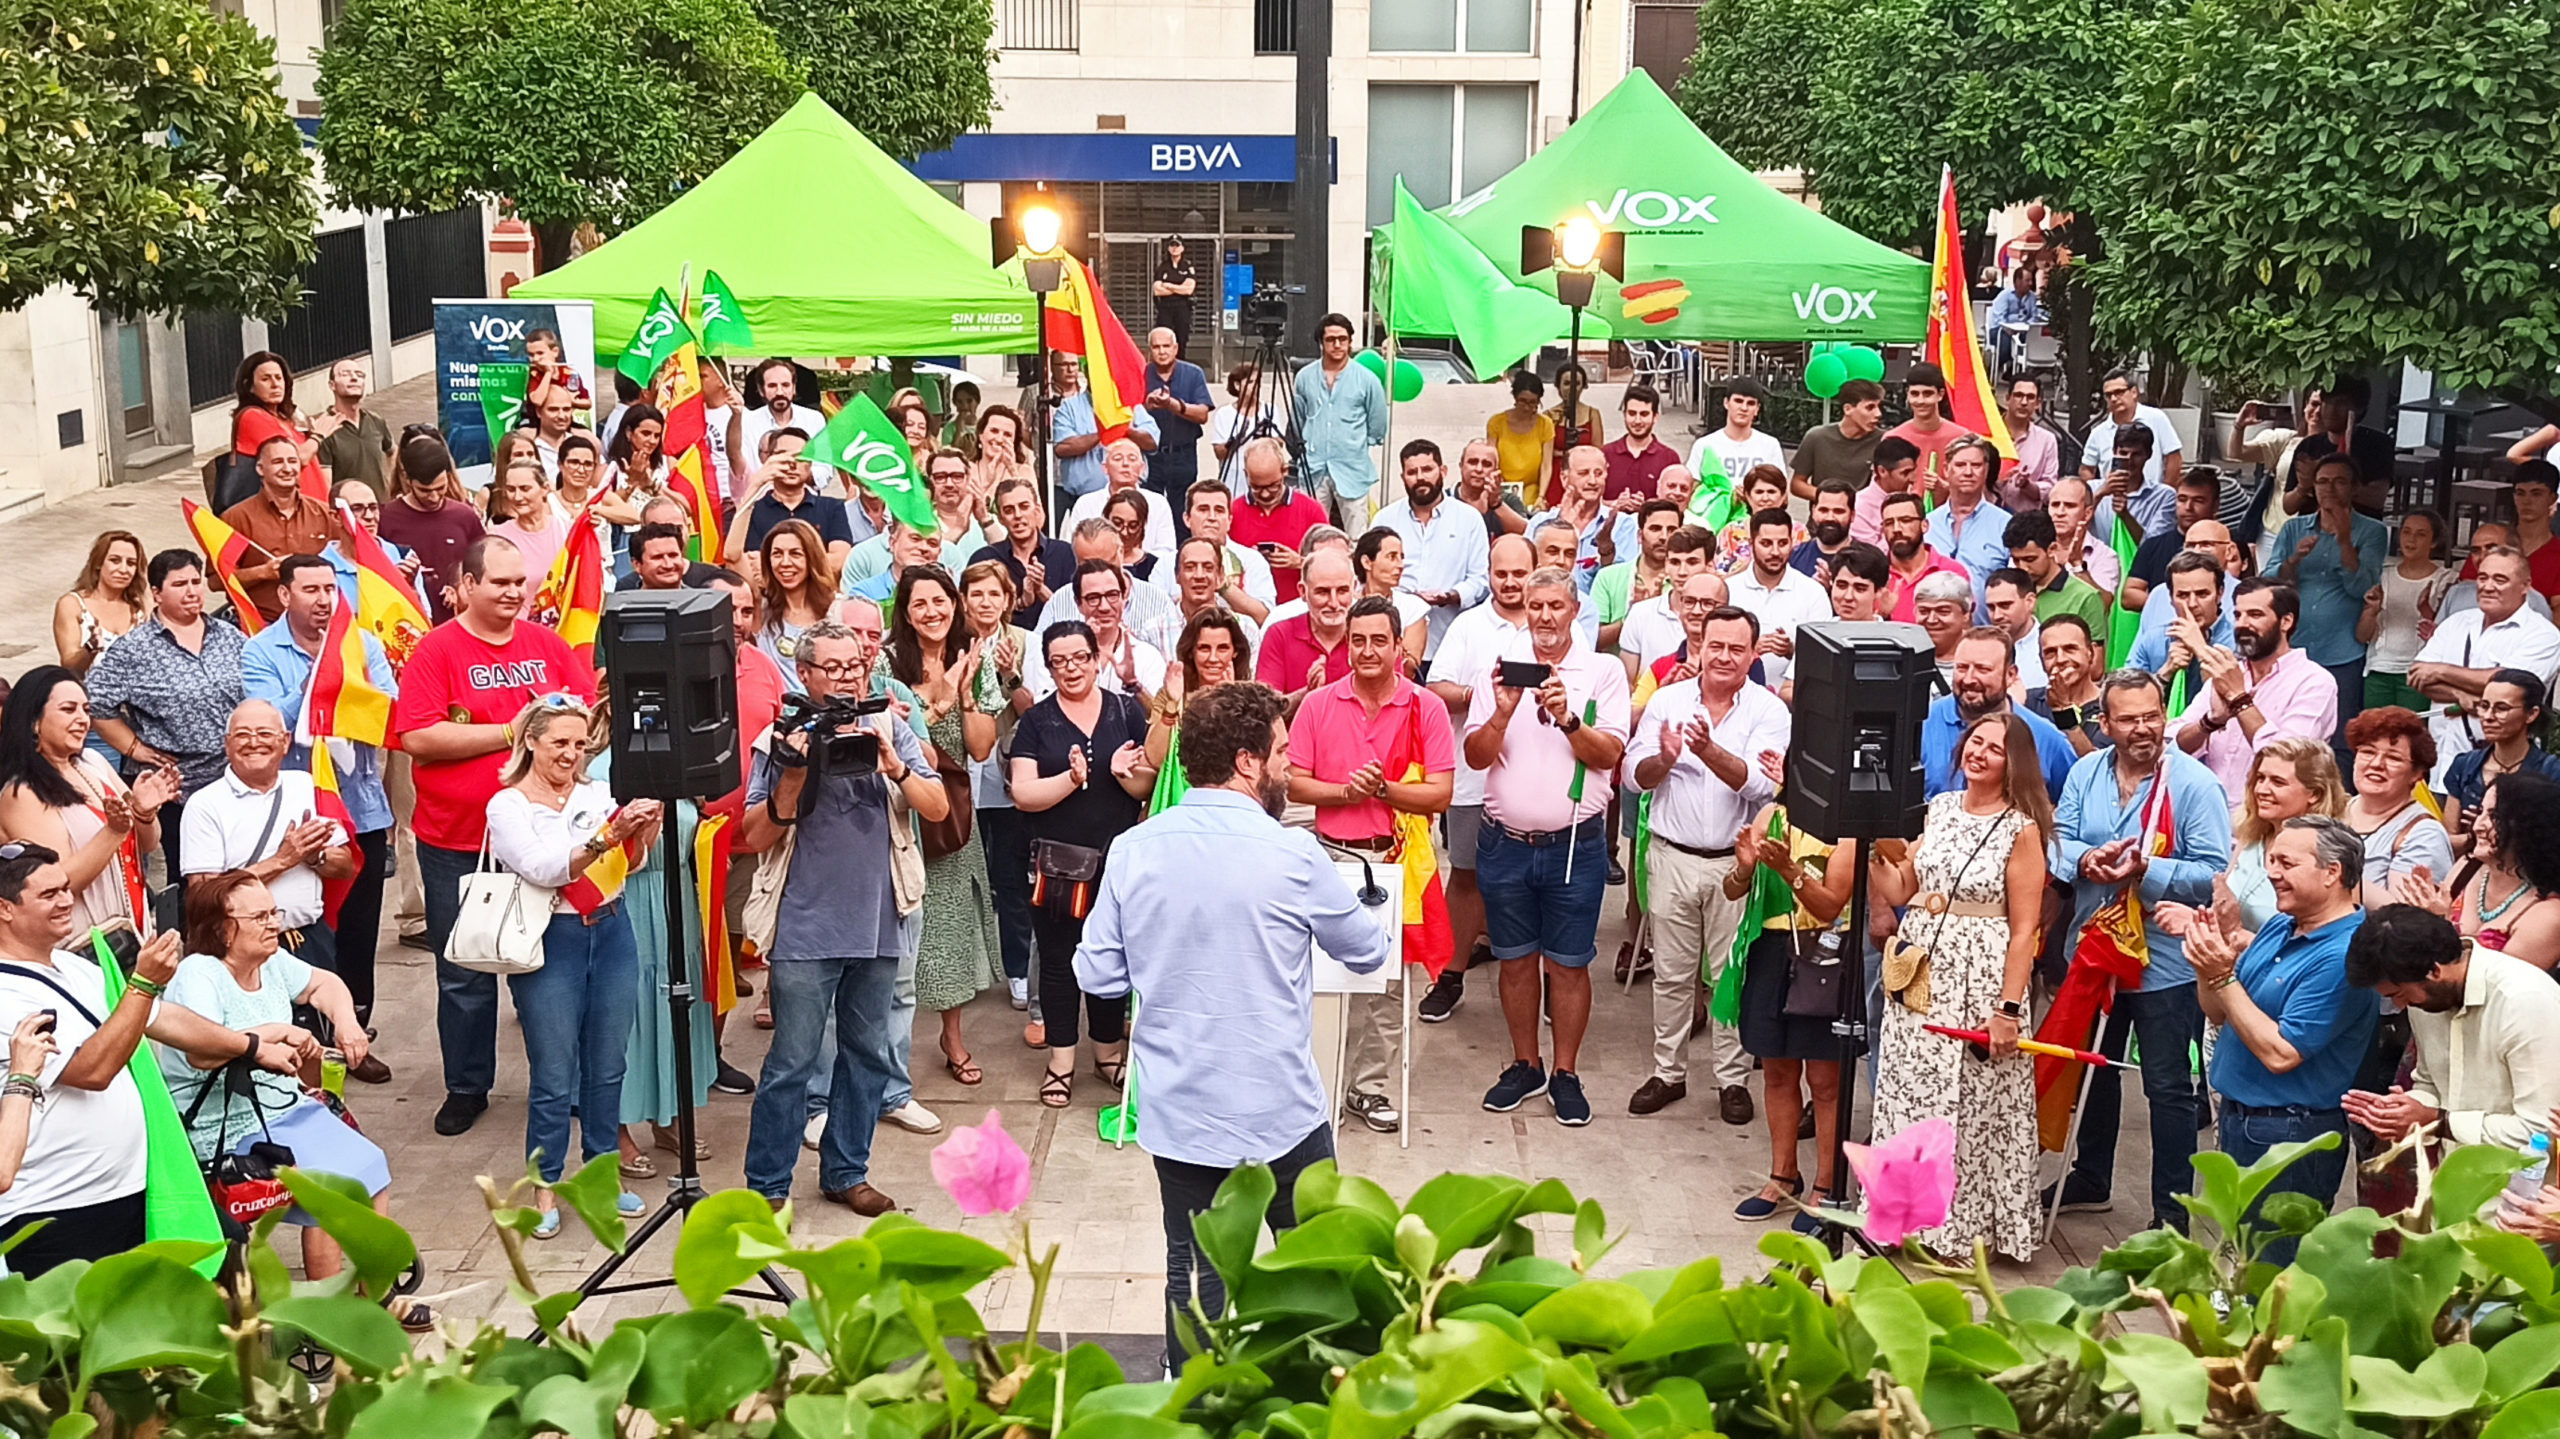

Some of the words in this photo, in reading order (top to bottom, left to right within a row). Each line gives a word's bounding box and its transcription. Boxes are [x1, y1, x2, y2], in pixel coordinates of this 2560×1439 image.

[1151, 142, 1242, 171] BBVA
[1586, 188, 1719, 227] VOX
[1792, 282, 1878, 324] VOX
[469, 314, 526, 343] VOX
[951, 312, 974, 324] SIN
[977, 312, 1024, 324] MIEDO
[468, 660, 547, 690] GANT
[230, 1189, 294, 1215] Cruzcamp
